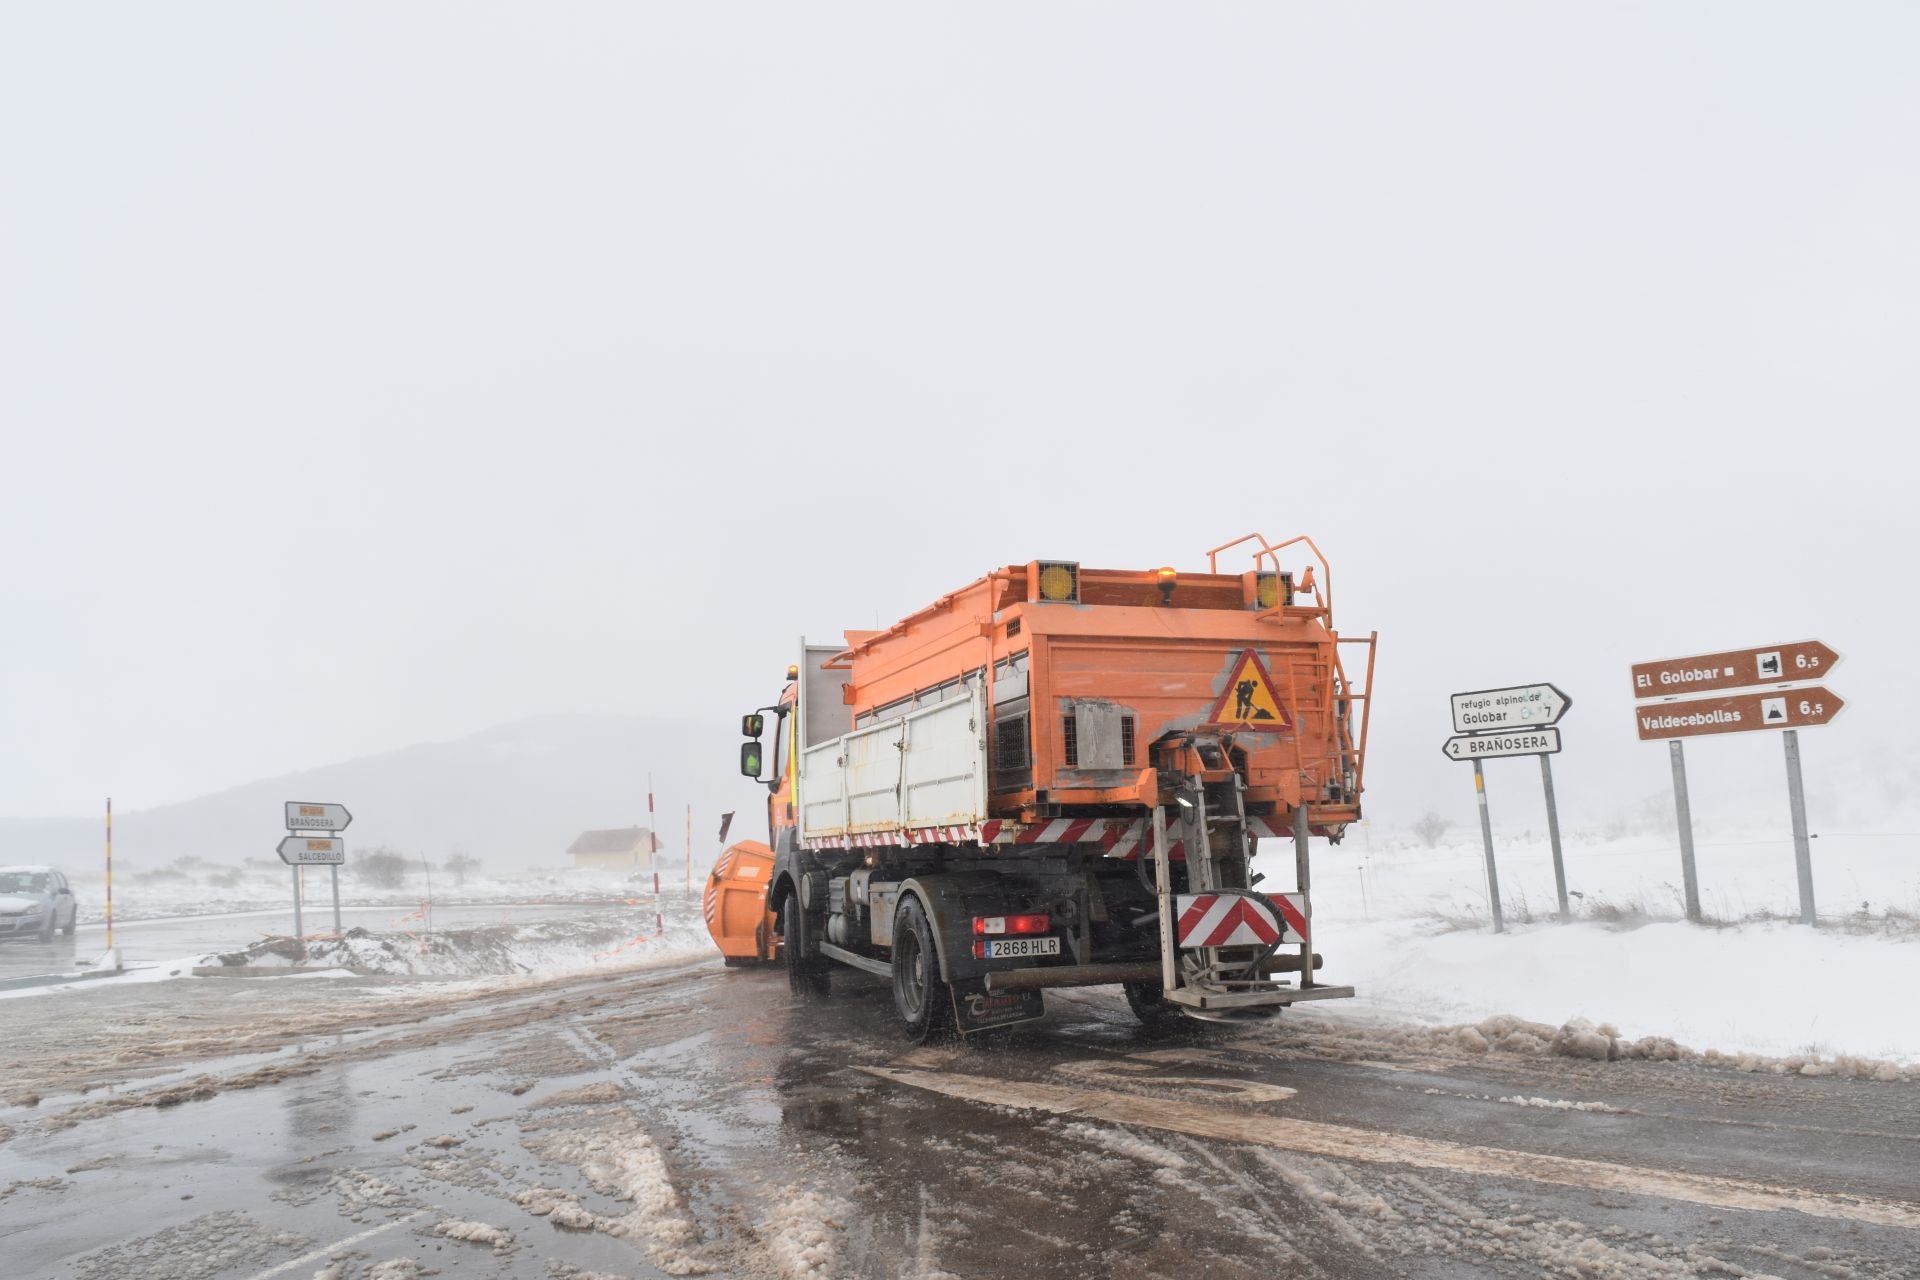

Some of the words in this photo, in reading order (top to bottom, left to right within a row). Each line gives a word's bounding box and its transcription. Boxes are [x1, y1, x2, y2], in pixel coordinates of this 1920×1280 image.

[1637, 674, 1652, 687] El
[1660, 667, 1719, 685] Golobar
[1795, 654, 1819, 669] 6,5
[1461, 698, 1491, 709] refugio
[1496, 694, 1523, 706] alpino
[1529, 693, 1541, 702] de
[1463, 711, 1507, 725] Golobar
[1544, 706, 1551, 717] 7
[1642, 709, 1741, 730] Valdecebollas
[1800, 701, 1823, 716] 6,5
[1452, 743, 1460, 754] 2
[1470, 736, 1548, 753] BRAÑOSERA
[298, 852, 342, 861] SALCEDILLO
[995, 942, 1028, 956] 2868
[1032, 940, 1056, 953] HLR
